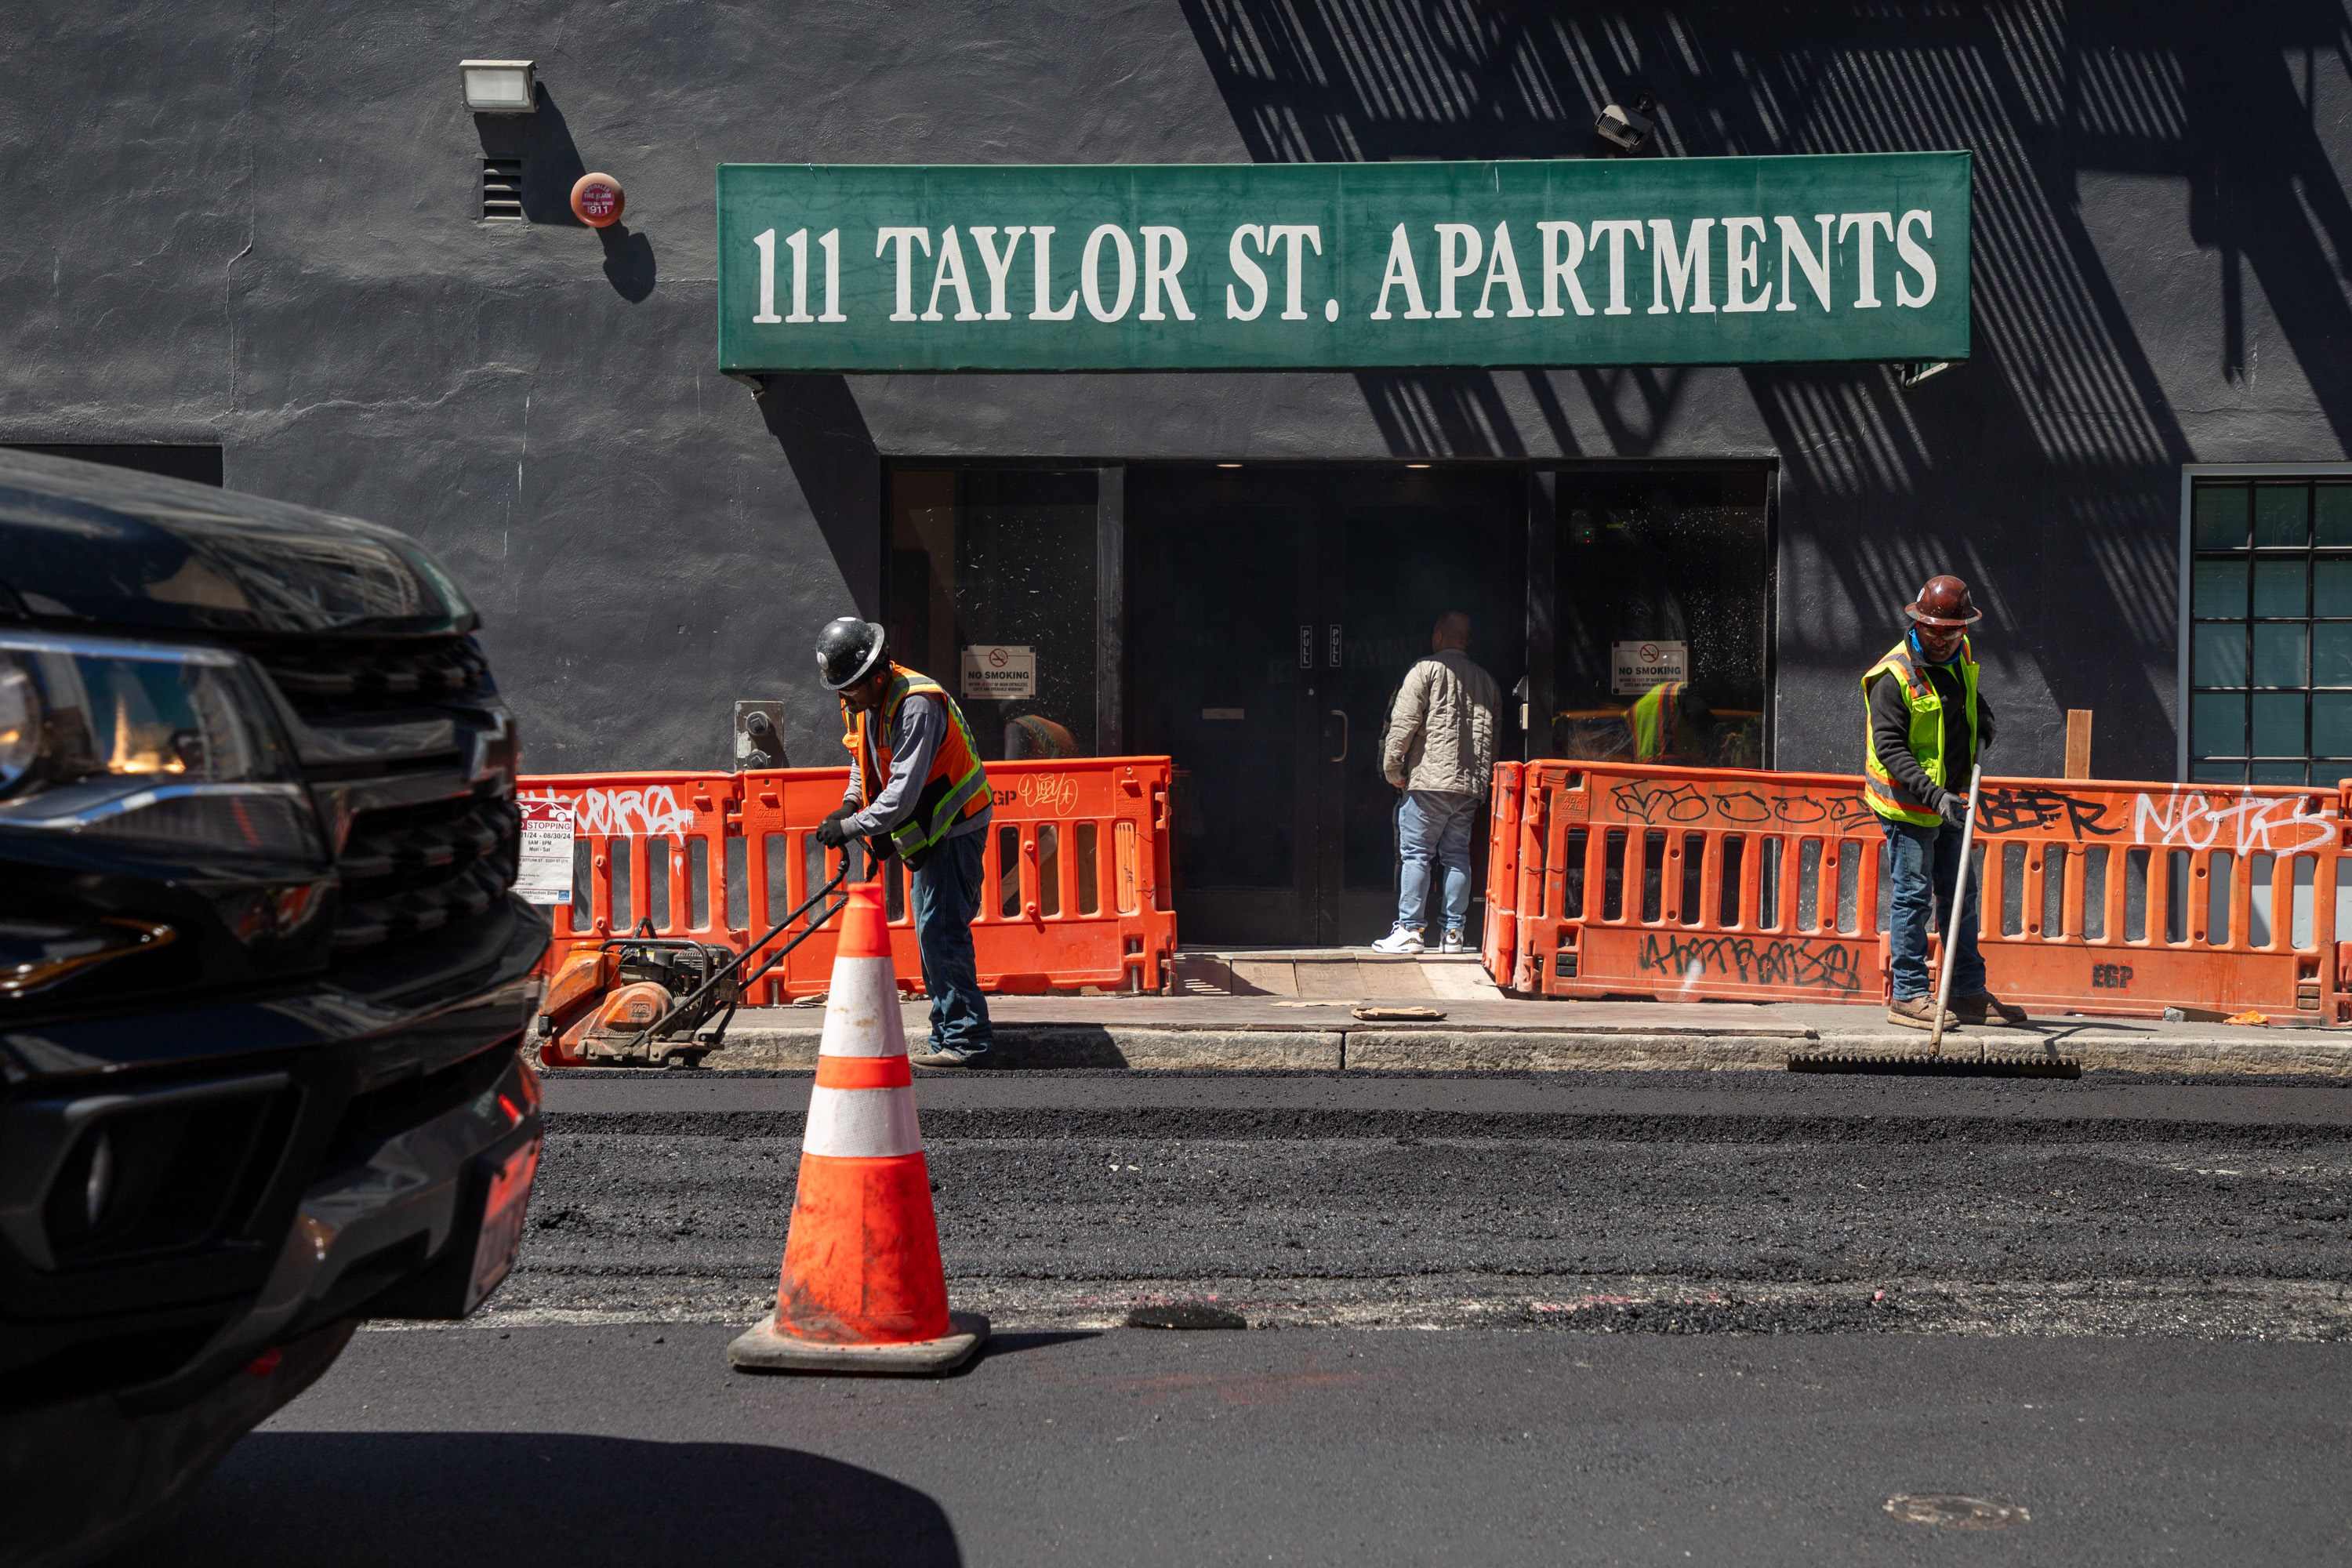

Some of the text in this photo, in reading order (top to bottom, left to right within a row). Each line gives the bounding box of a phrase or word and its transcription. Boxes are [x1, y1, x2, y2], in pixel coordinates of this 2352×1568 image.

[585, 183, 610, 193] SPRINKLER
[590, 205, 608, 214] 911
[752, 209, 1938, 324] 111 TAYLOR ST. APARTMENTS
[1619, 666, 1681, 675] NO SMOKING
[993, 790, 1017, 806] GP
[1562, 803, 1584, 811] WALL
[2092, 964, 2133, 988] EGP
